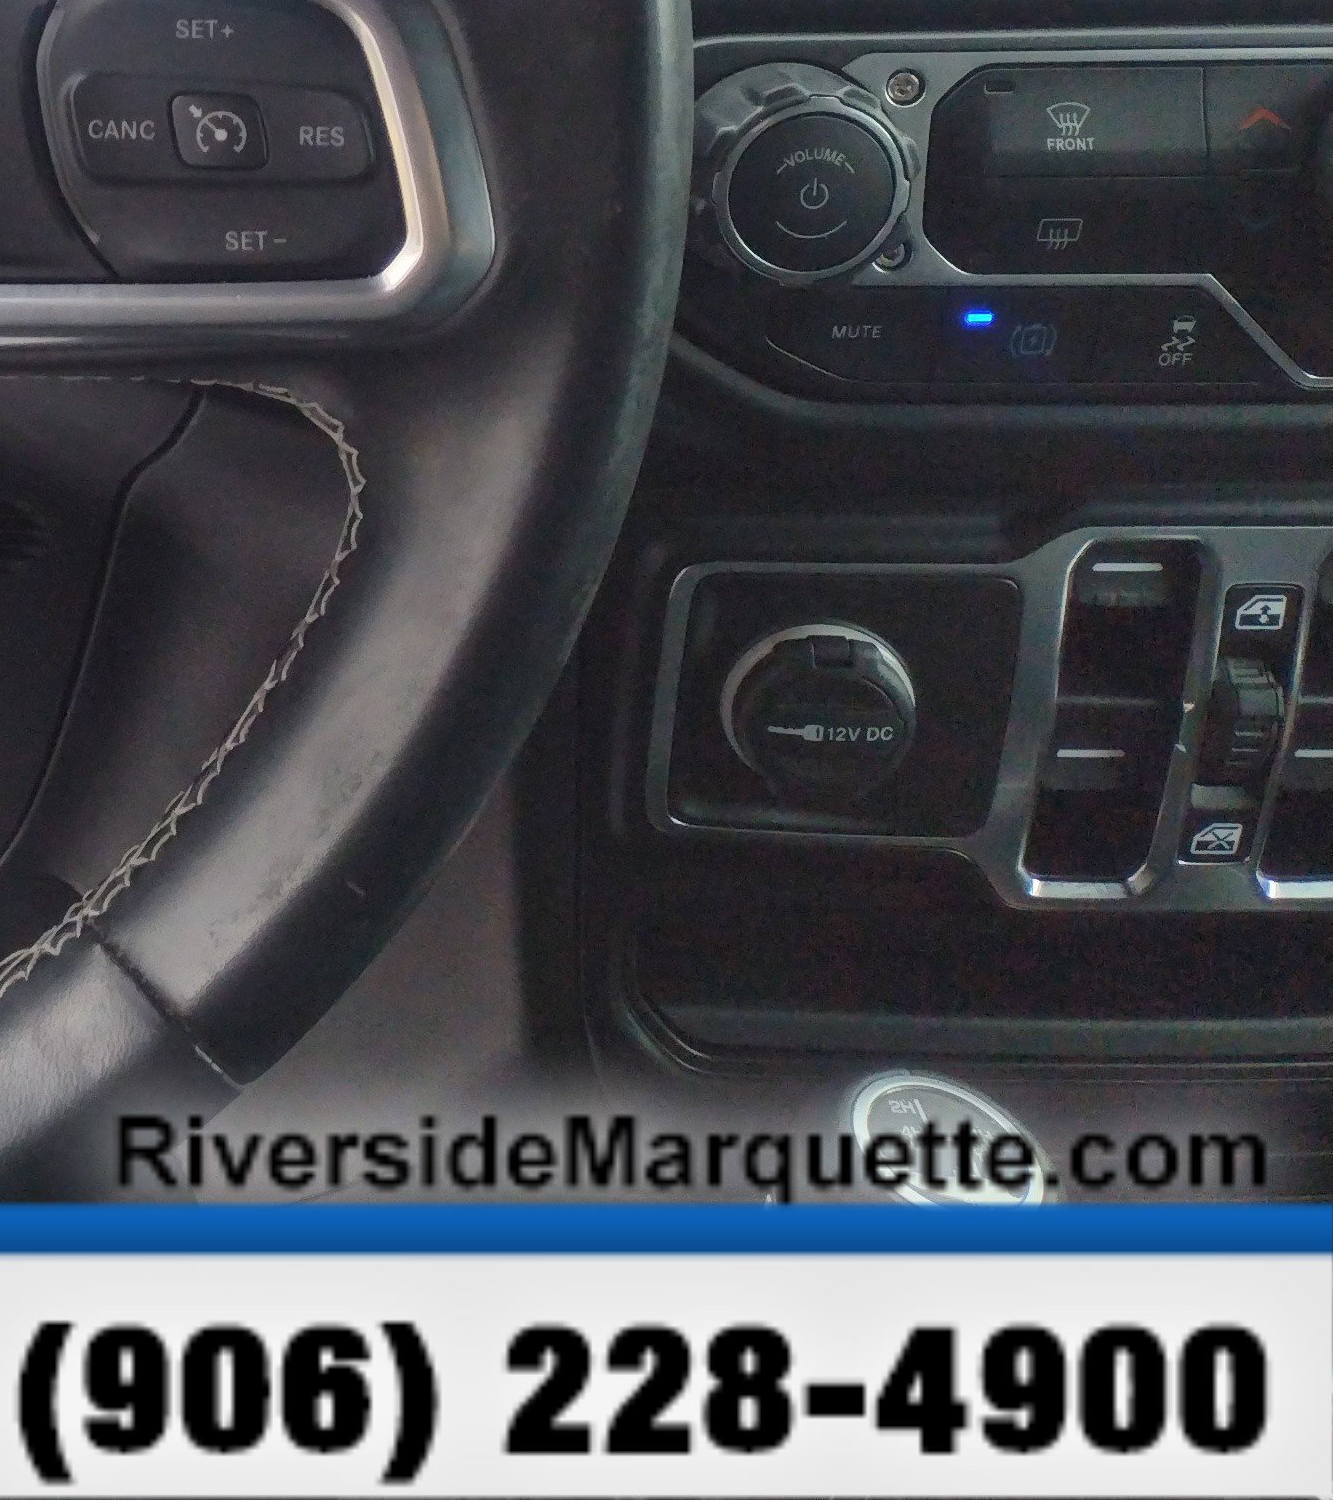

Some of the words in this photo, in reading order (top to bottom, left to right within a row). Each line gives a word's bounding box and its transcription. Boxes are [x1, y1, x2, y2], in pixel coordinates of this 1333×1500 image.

[88, 118, 156, 141] CANC
[297, 124, 345, 147] RES
[1046, 137, 1095, 152] FRONT
[783, 146, 846, 168] VOLUME
[831, 323, 883, 340] MUTE
[1158, 350, 1193, 366] OFF
[827, 726, 861, 742] 12V
[866, 726, 894, 742] DC
